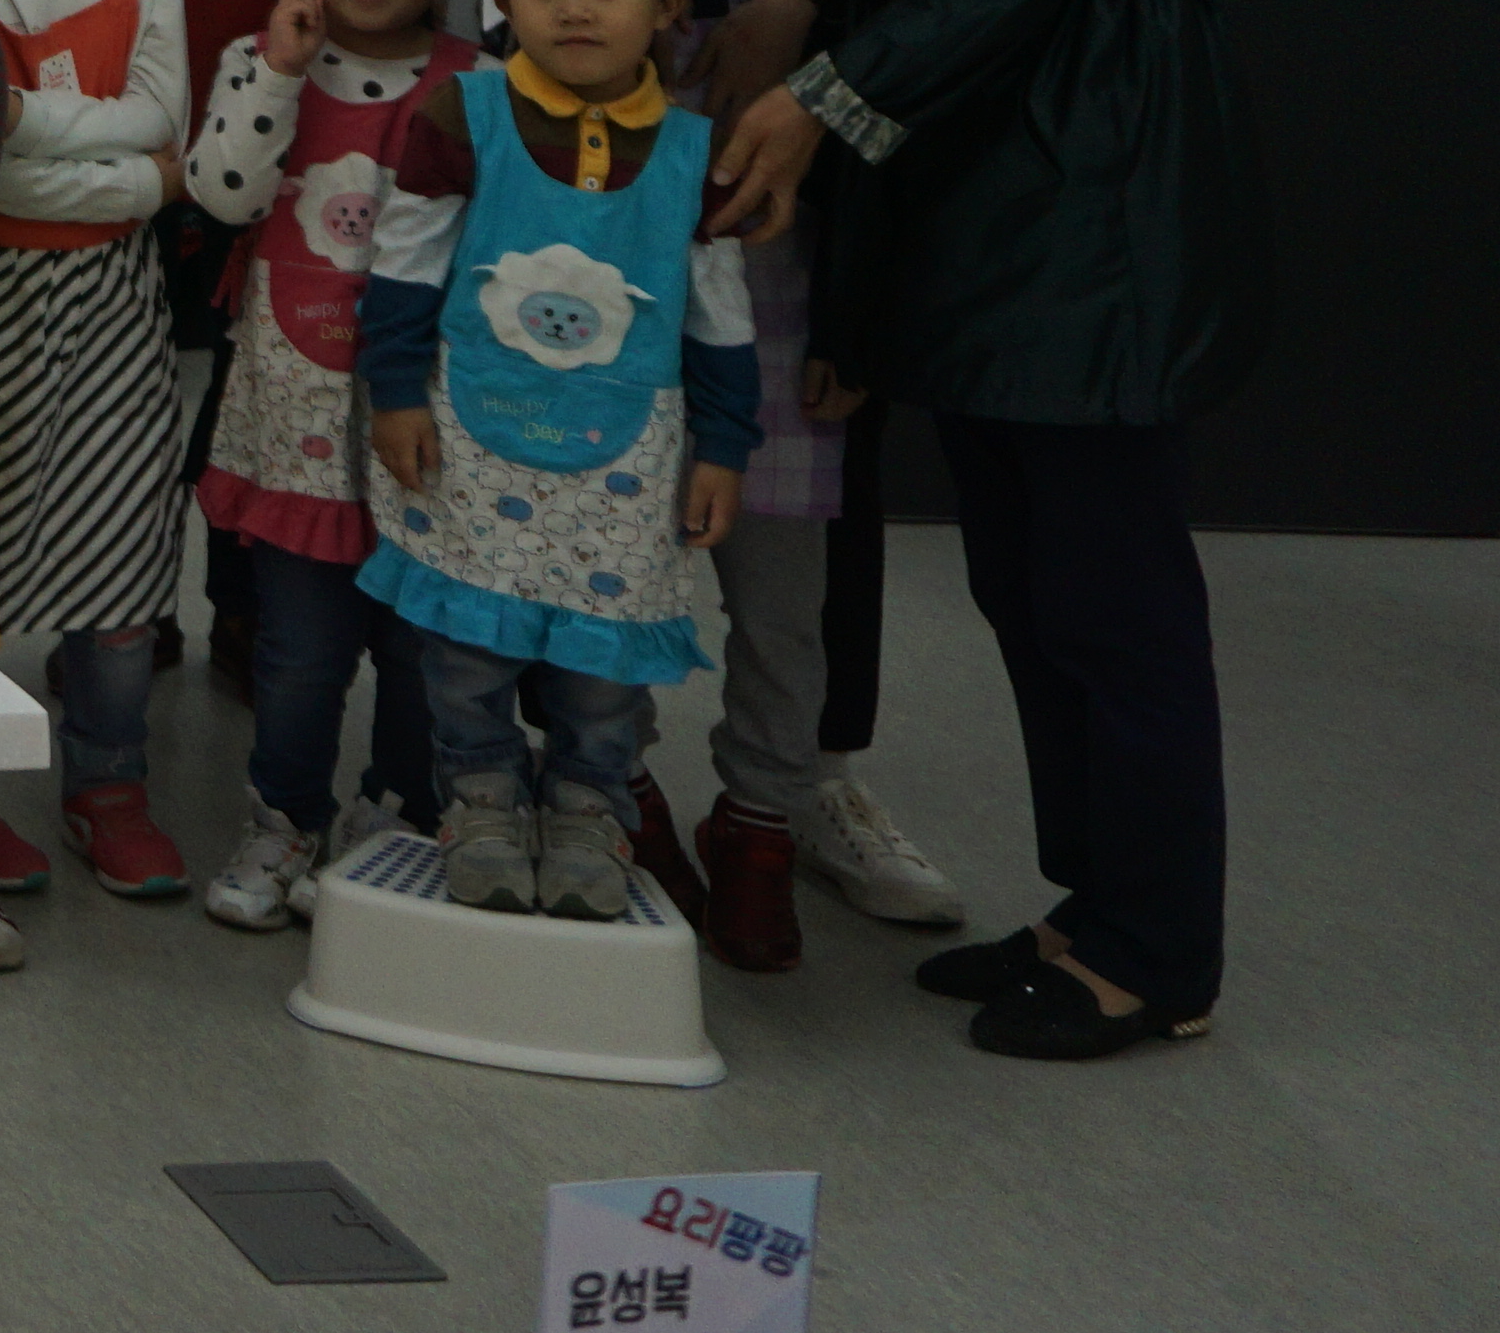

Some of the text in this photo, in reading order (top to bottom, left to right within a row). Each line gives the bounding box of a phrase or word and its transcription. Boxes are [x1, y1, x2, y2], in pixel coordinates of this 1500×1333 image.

[320, 322, 355, 343] Day
[523, 421, 566, 445] Day
[640, 1185, 811, 1278] 요리팡팡
